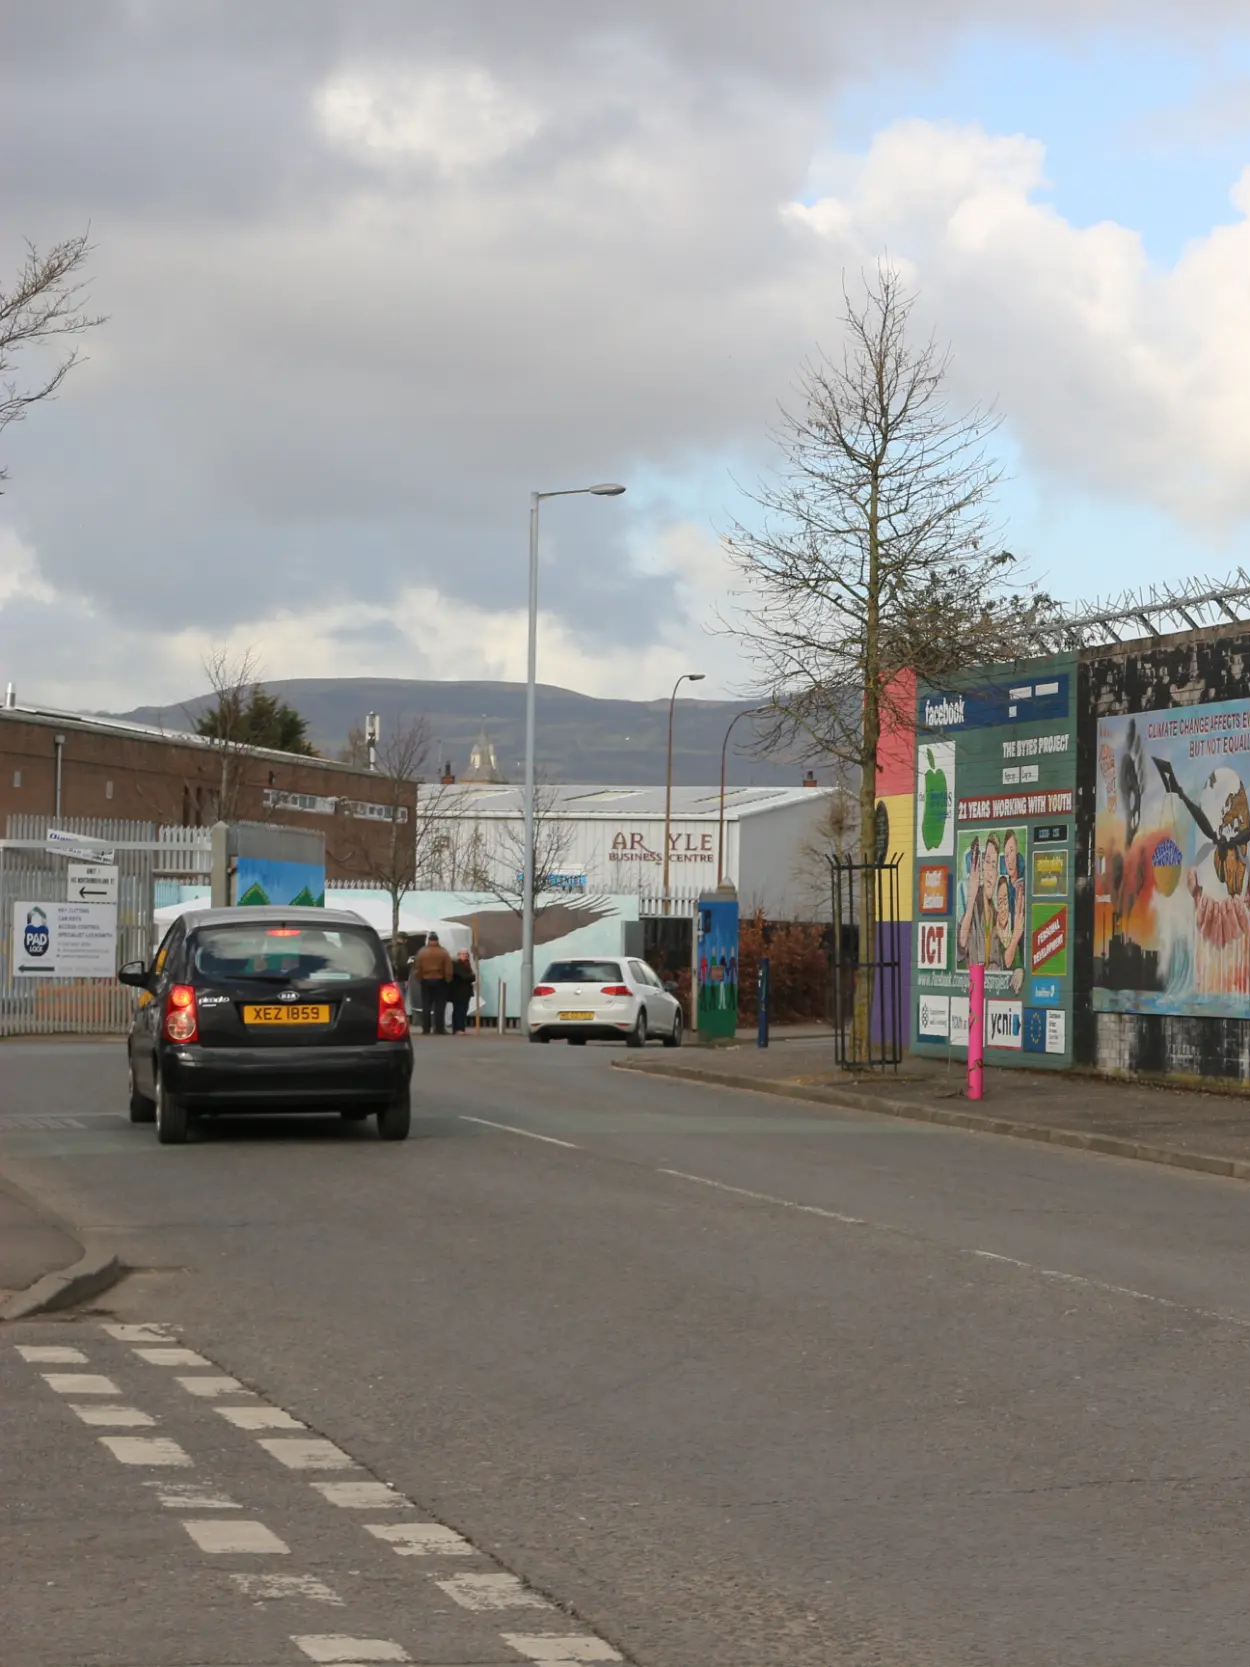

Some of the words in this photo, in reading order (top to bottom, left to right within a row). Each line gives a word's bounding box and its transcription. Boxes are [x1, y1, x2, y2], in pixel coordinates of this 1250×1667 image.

[925, 695, 965, 726] facebook
[1148, 721, 1178, 740] CLIMATE
[1179, 717, 1209, 735] CHANGE
[1210, 713, 1240, 732] AFFECTS
[1003, 741, 1016, 758] THE
[1038, 733, 1070, 755] PROJECT
[1189, 741, 1204, 758] BUT
[1206, 738, 1221, 755] NOT
[958, 802, 968, 820] 21
[968, 800, 991, 819] YEARS
[992, 797, 1027, 818] WORKING
[1027, 795, 1046, 814] WITH
[1047, 792, 1072, 812] YOUTH
[609, 852, 663, 862] BUSINESS
[668, 854, 714, 863] CENTRE
[26, 933, 47, 945] PAD
[921, 925, 944, 964] ICT
[1037, 918, 1061, 946] PERSONAL
[1033, 933, 1064, 967] DEVELOPMENT
[253, 1007, 283, 1020] XEZ
[286, 1006, 320, 1020] 1859
[991, 1008, 1012, 1040] ycni
